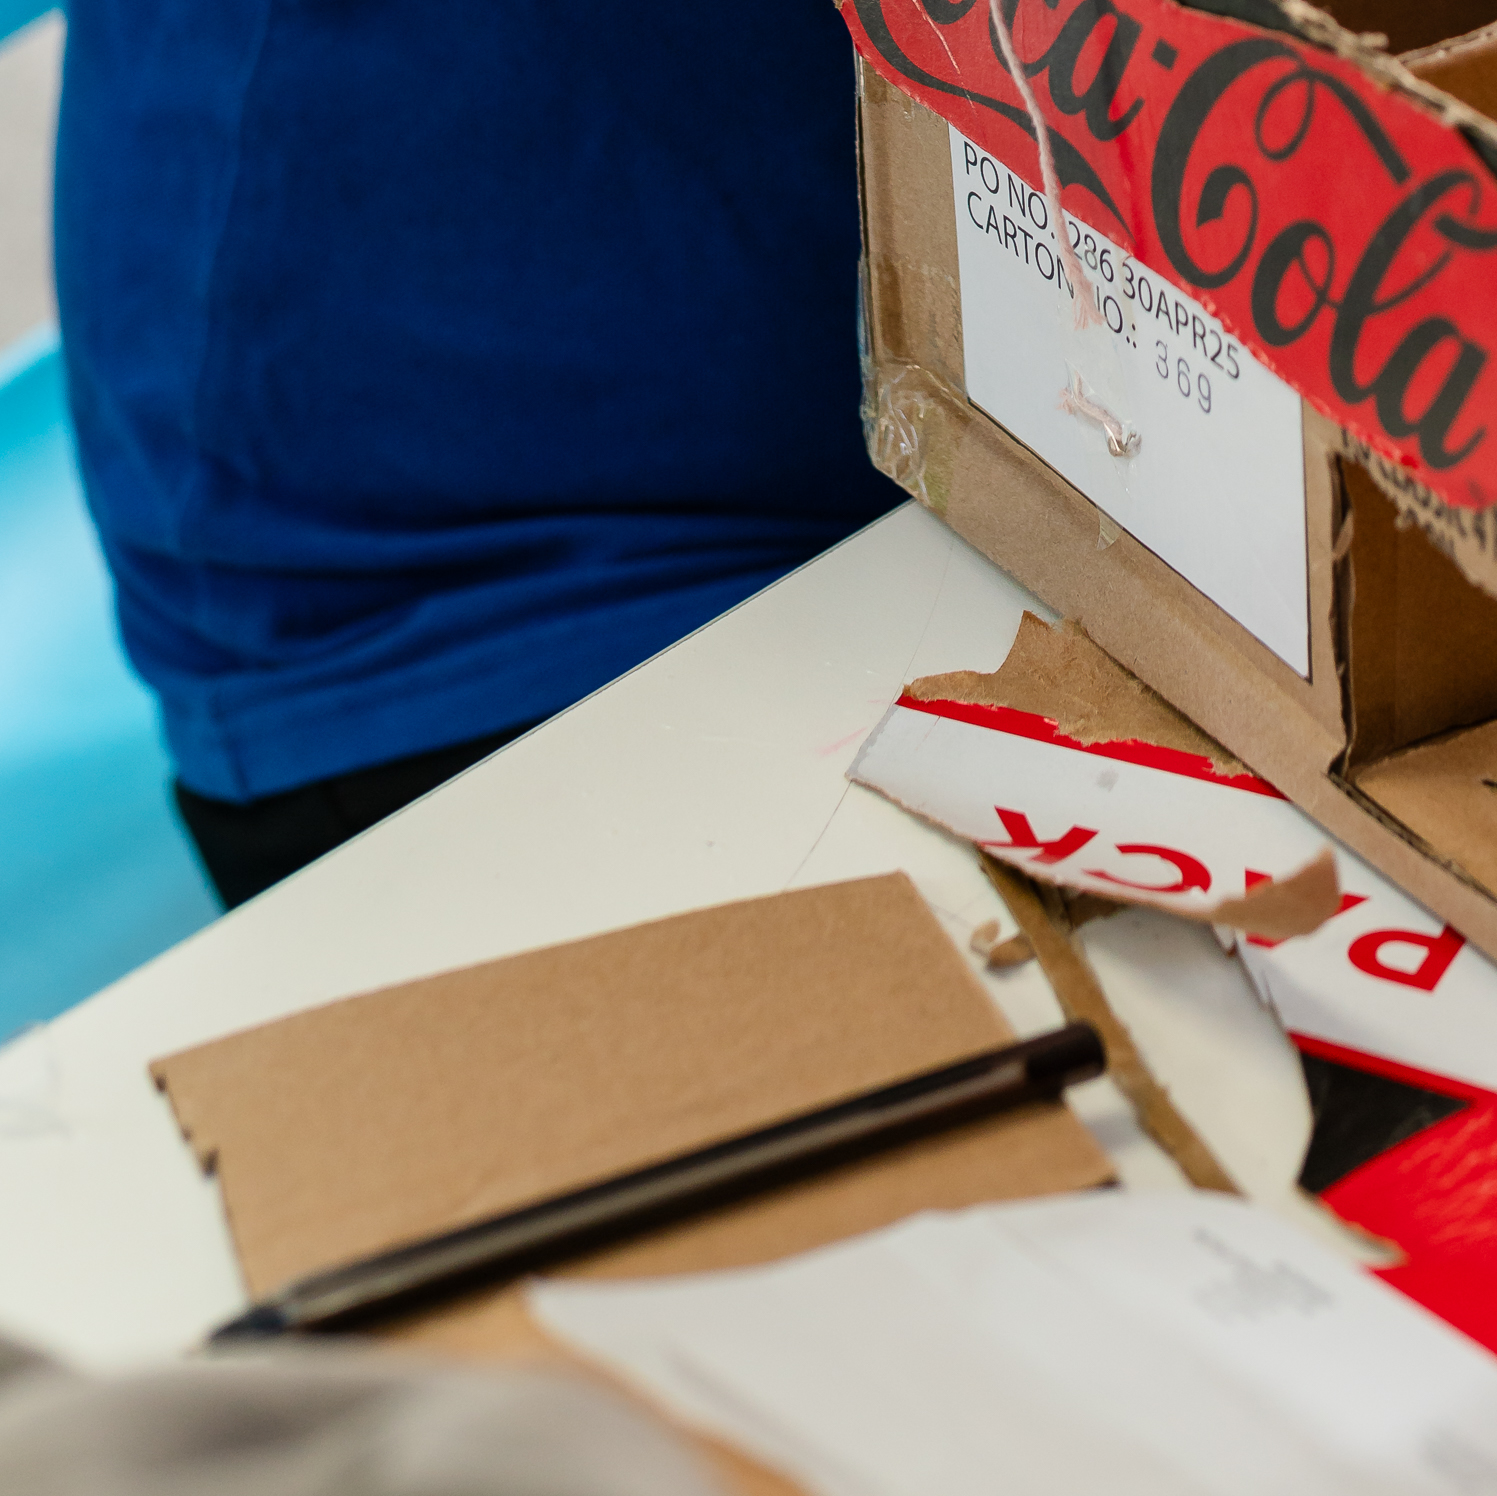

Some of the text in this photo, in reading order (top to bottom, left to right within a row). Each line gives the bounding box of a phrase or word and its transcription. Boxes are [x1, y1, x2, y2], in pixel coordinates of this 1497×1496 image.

[963, 140, 1000, 195] PO
[1007, 172, 1055, 240] NO.
[1096, 285, 1137, 349] O.:
[1155, 340, 1213, 414] 369
